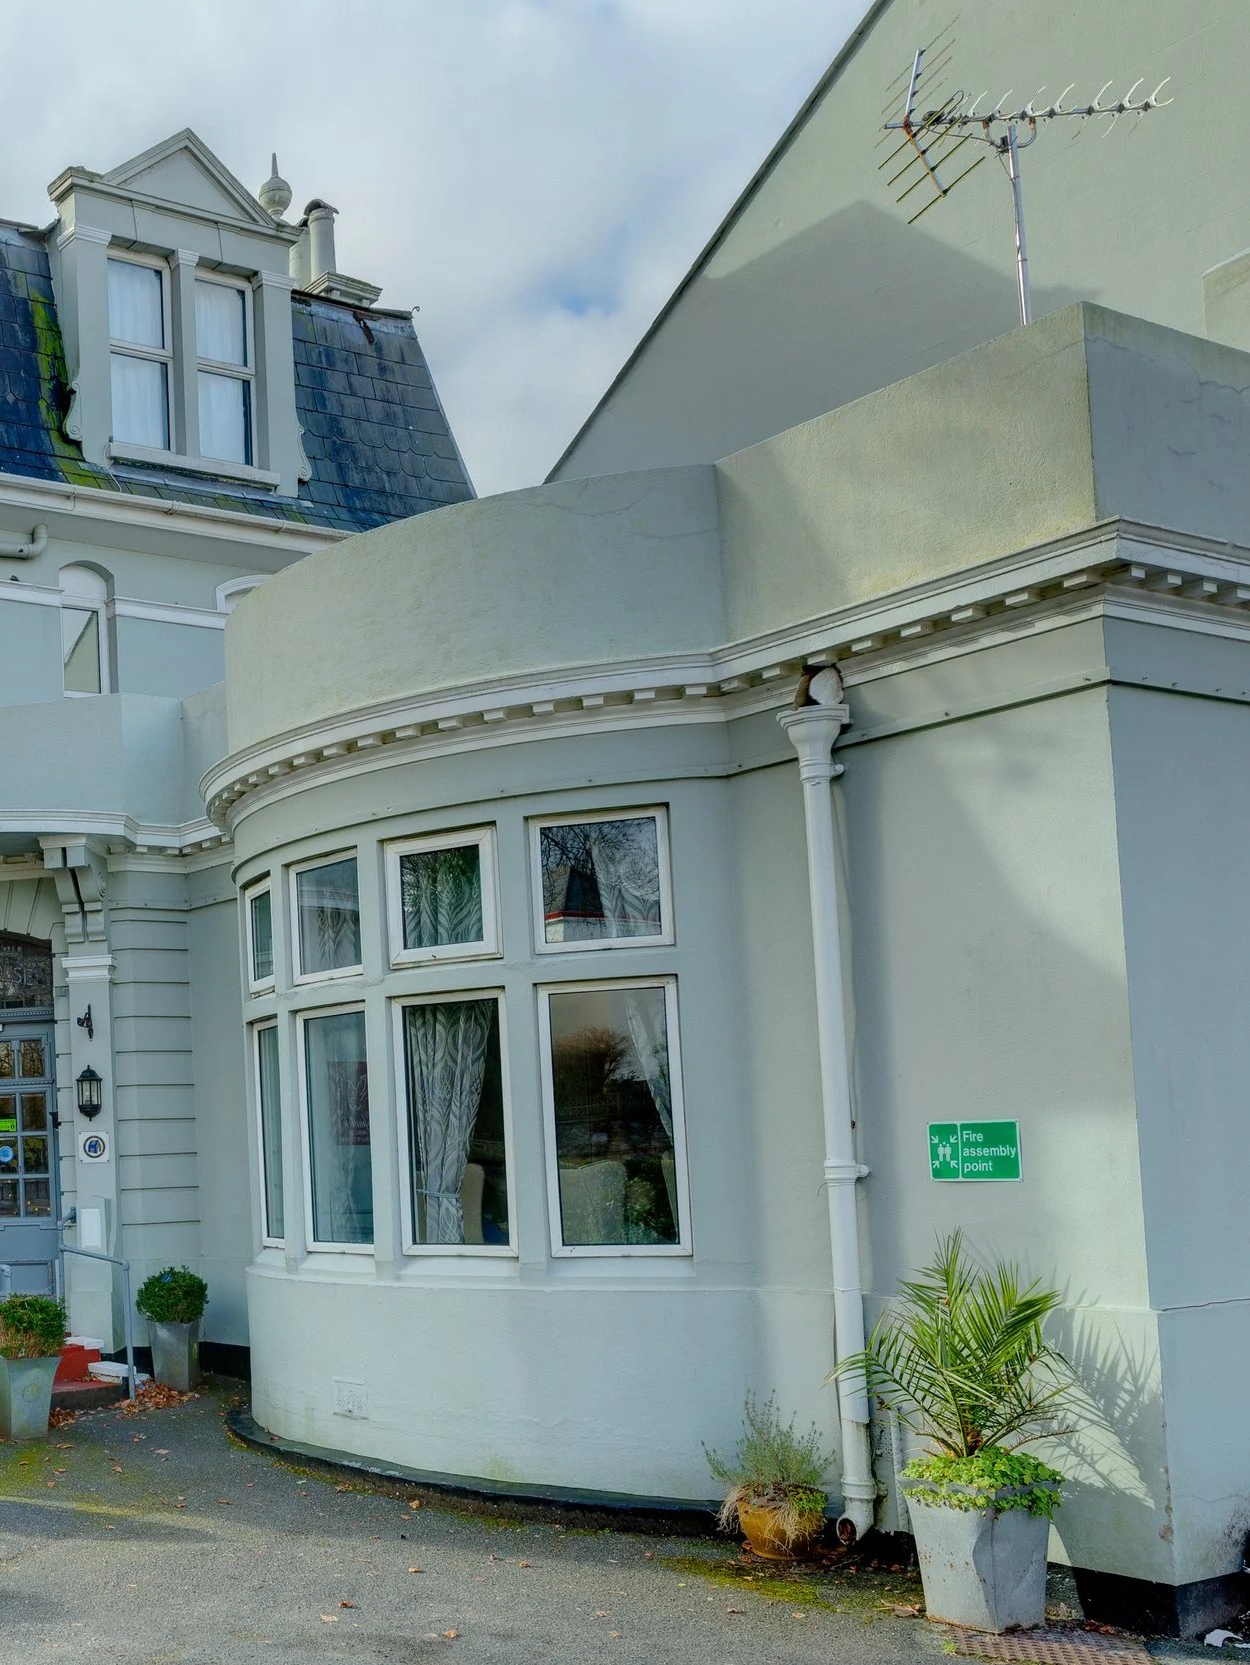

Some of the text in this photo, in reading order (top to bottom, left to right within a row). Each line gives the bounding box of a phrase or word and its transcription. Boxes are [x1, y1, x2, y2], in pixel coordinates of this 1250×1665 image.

[962, 1131, 984, 1142] Fire
[962, 1144, 1017, 1158] assembly
[964, 1160, 994, 1174] point
